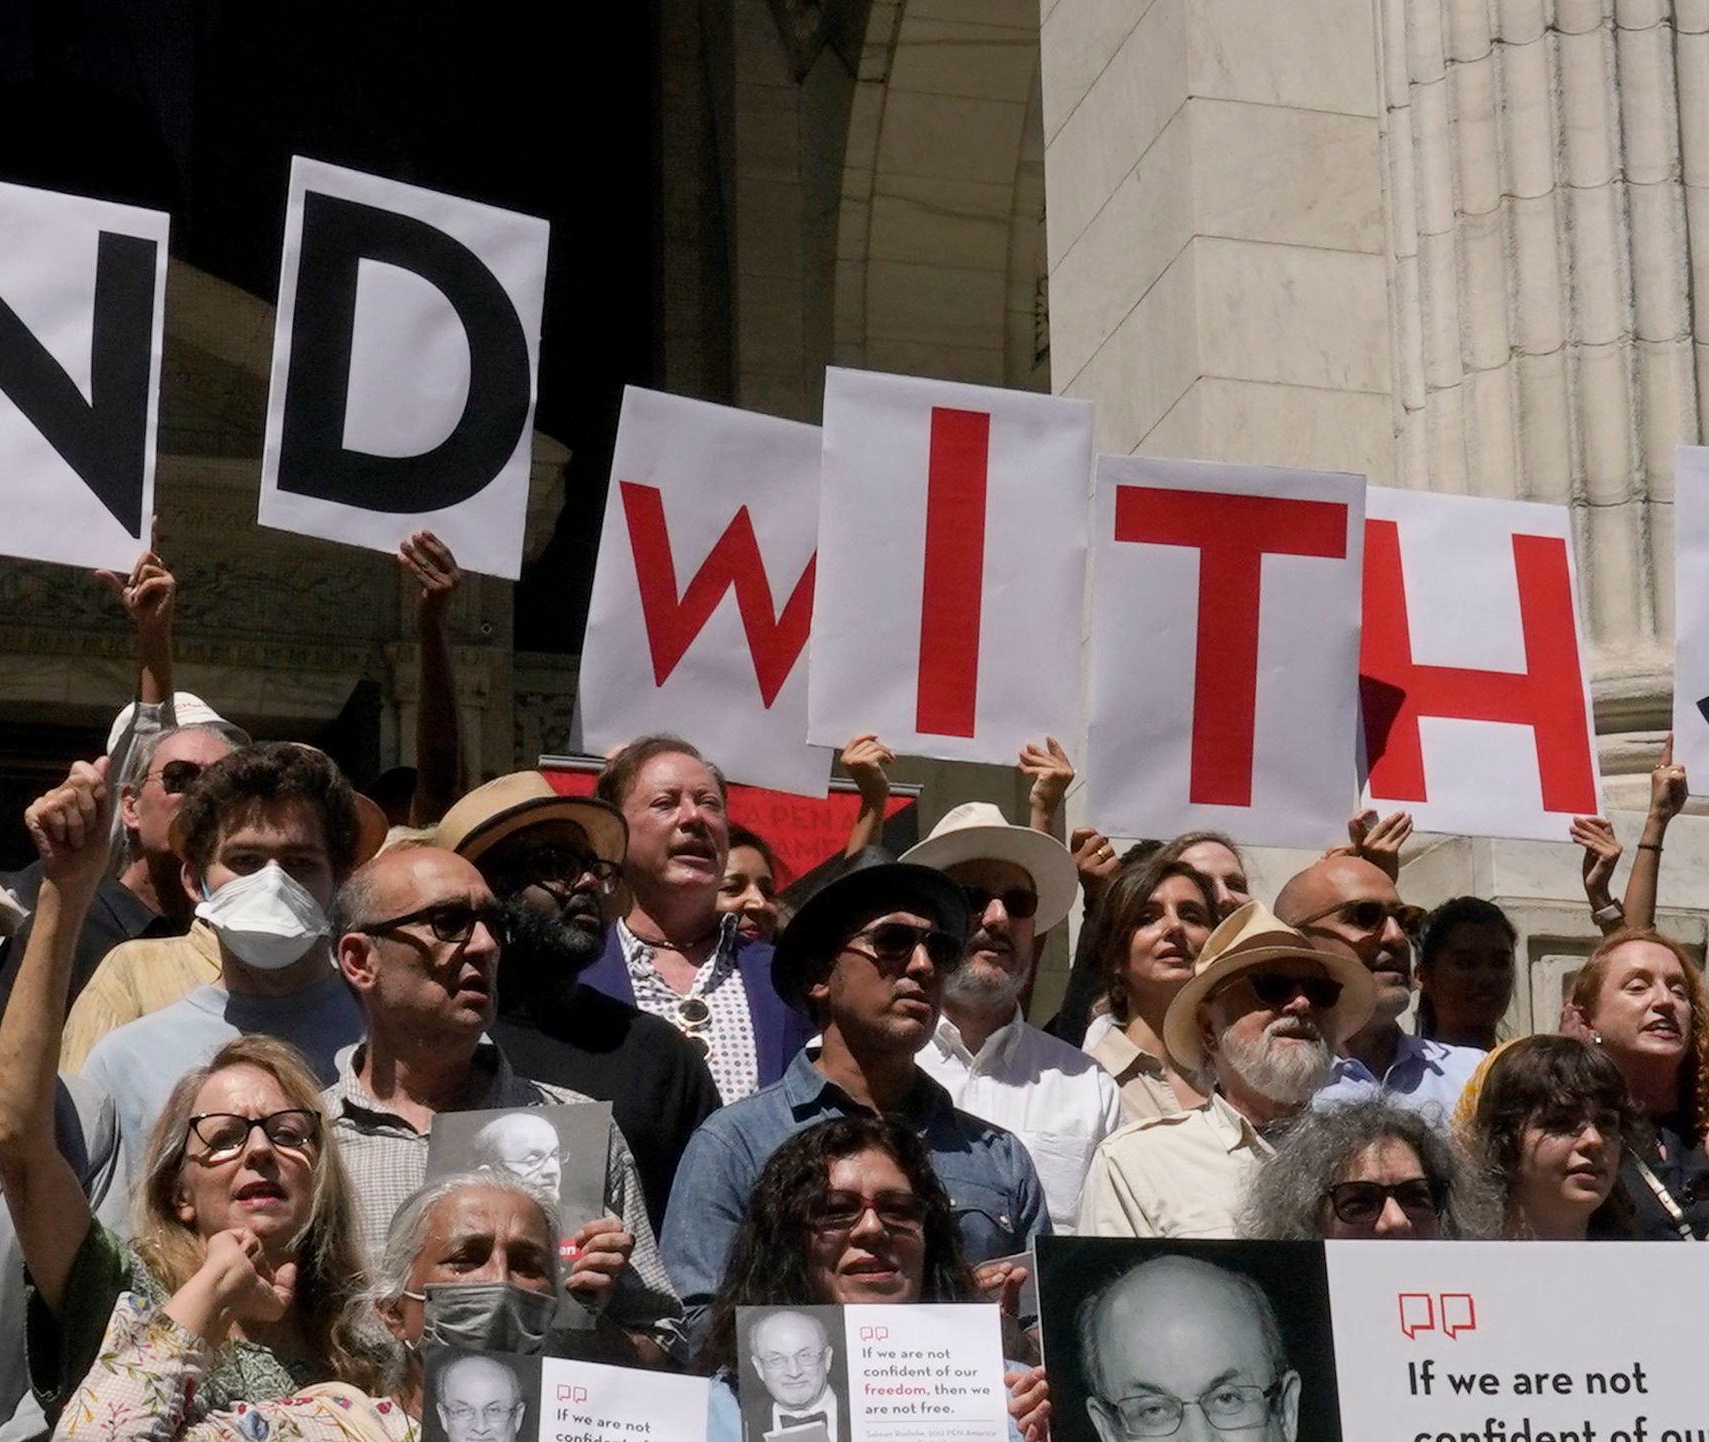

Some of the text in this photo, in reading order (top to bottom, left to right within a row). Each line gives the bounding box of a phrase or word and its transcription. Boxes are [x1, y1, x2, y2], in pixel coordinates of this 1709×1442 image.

[862, 1347, 951, 1359] If we are not
[864, 1366, 978, 1377] confident of our
[1408, 1359, 1649, 1395] If we are not
[865, 1384, 991, 1396] freedom, then we
[865, 1402, 955, 1415] are not free.
[557, 1409, 651, 1433] If we are not
